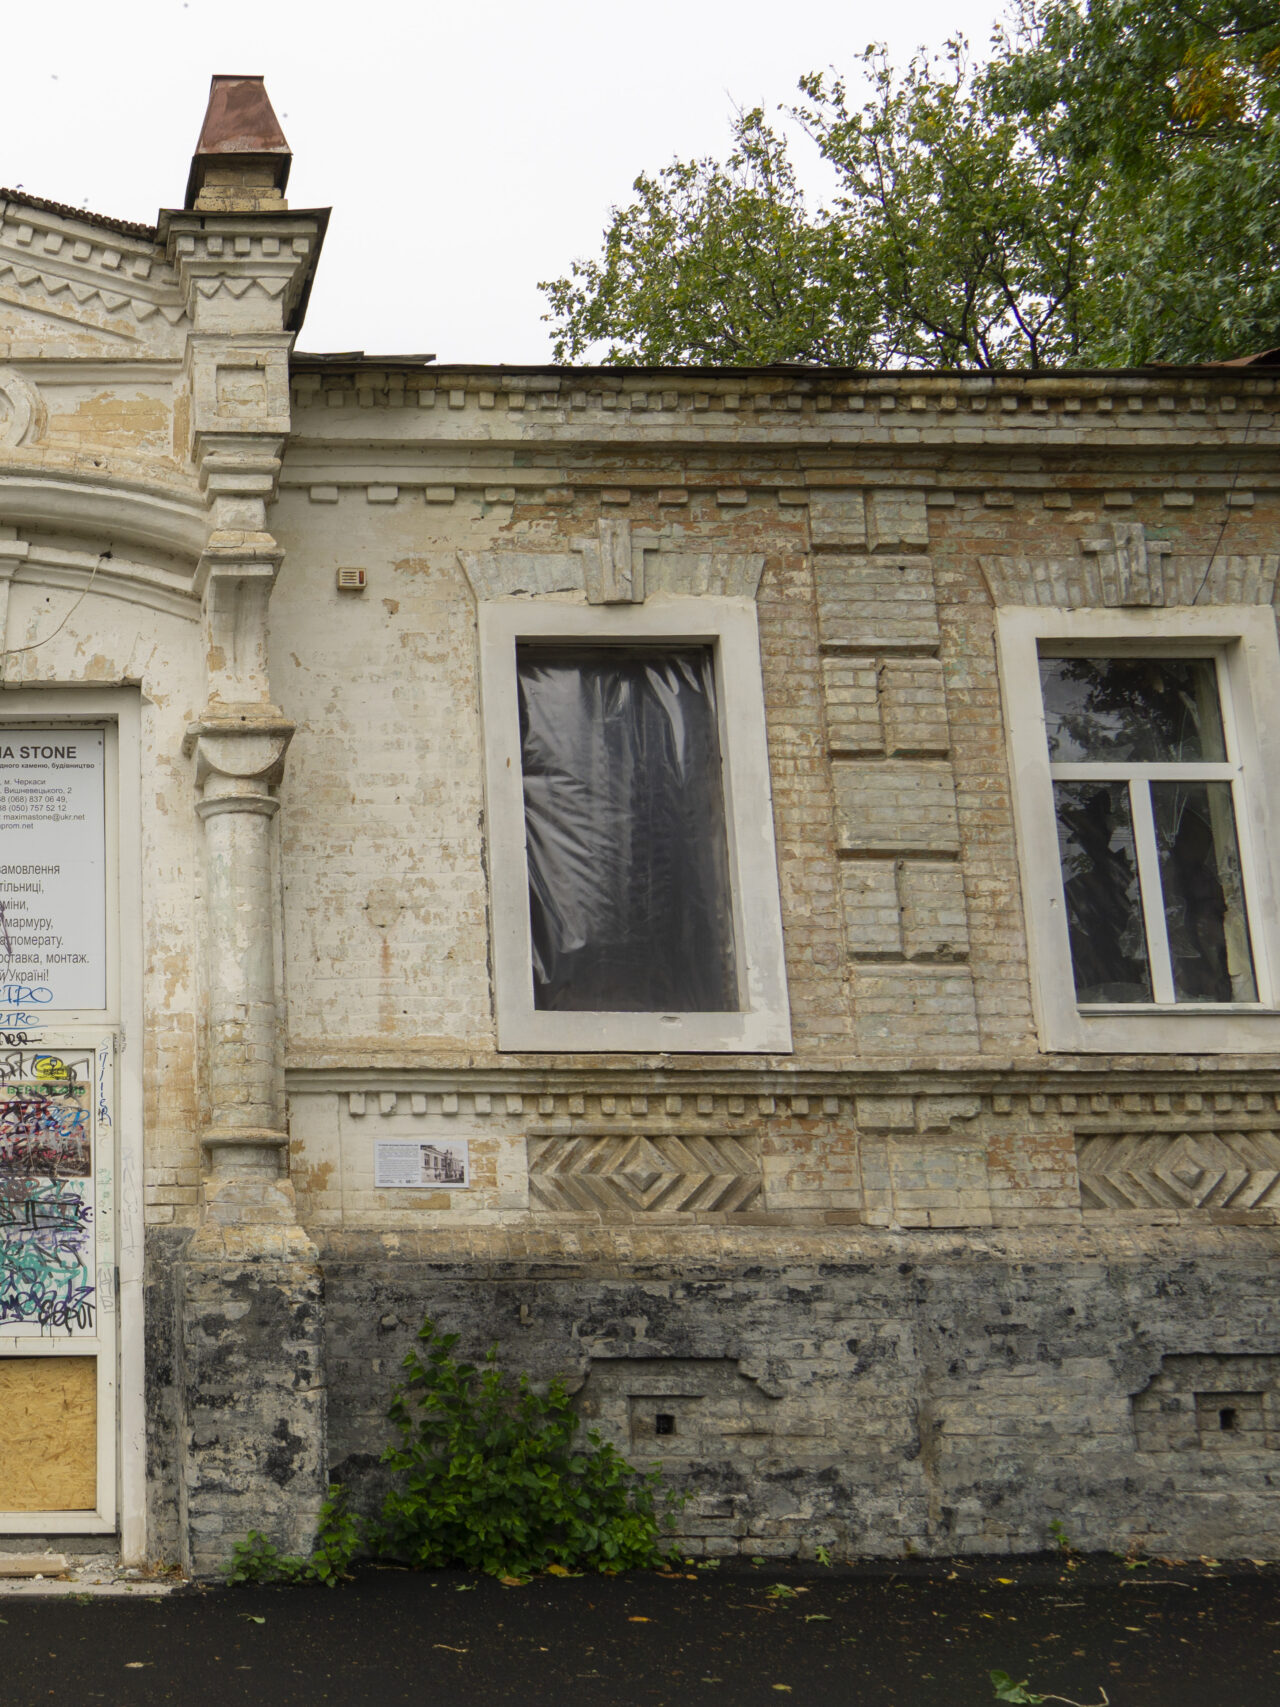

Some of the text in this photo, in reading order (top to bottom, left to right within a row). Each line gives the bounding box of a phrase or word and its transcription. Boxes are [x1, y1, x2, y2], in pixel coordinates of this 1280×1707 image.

[19, 746, 77, 759] STONE
[51, 762, 95, 770] будівництво
[14, 779, 46, 787] Черкаси
[4, 918, 54, 931] мармуру,
[46, 953, 90, 964] монтаж.
[9, 969, 49, 984] Україні!
